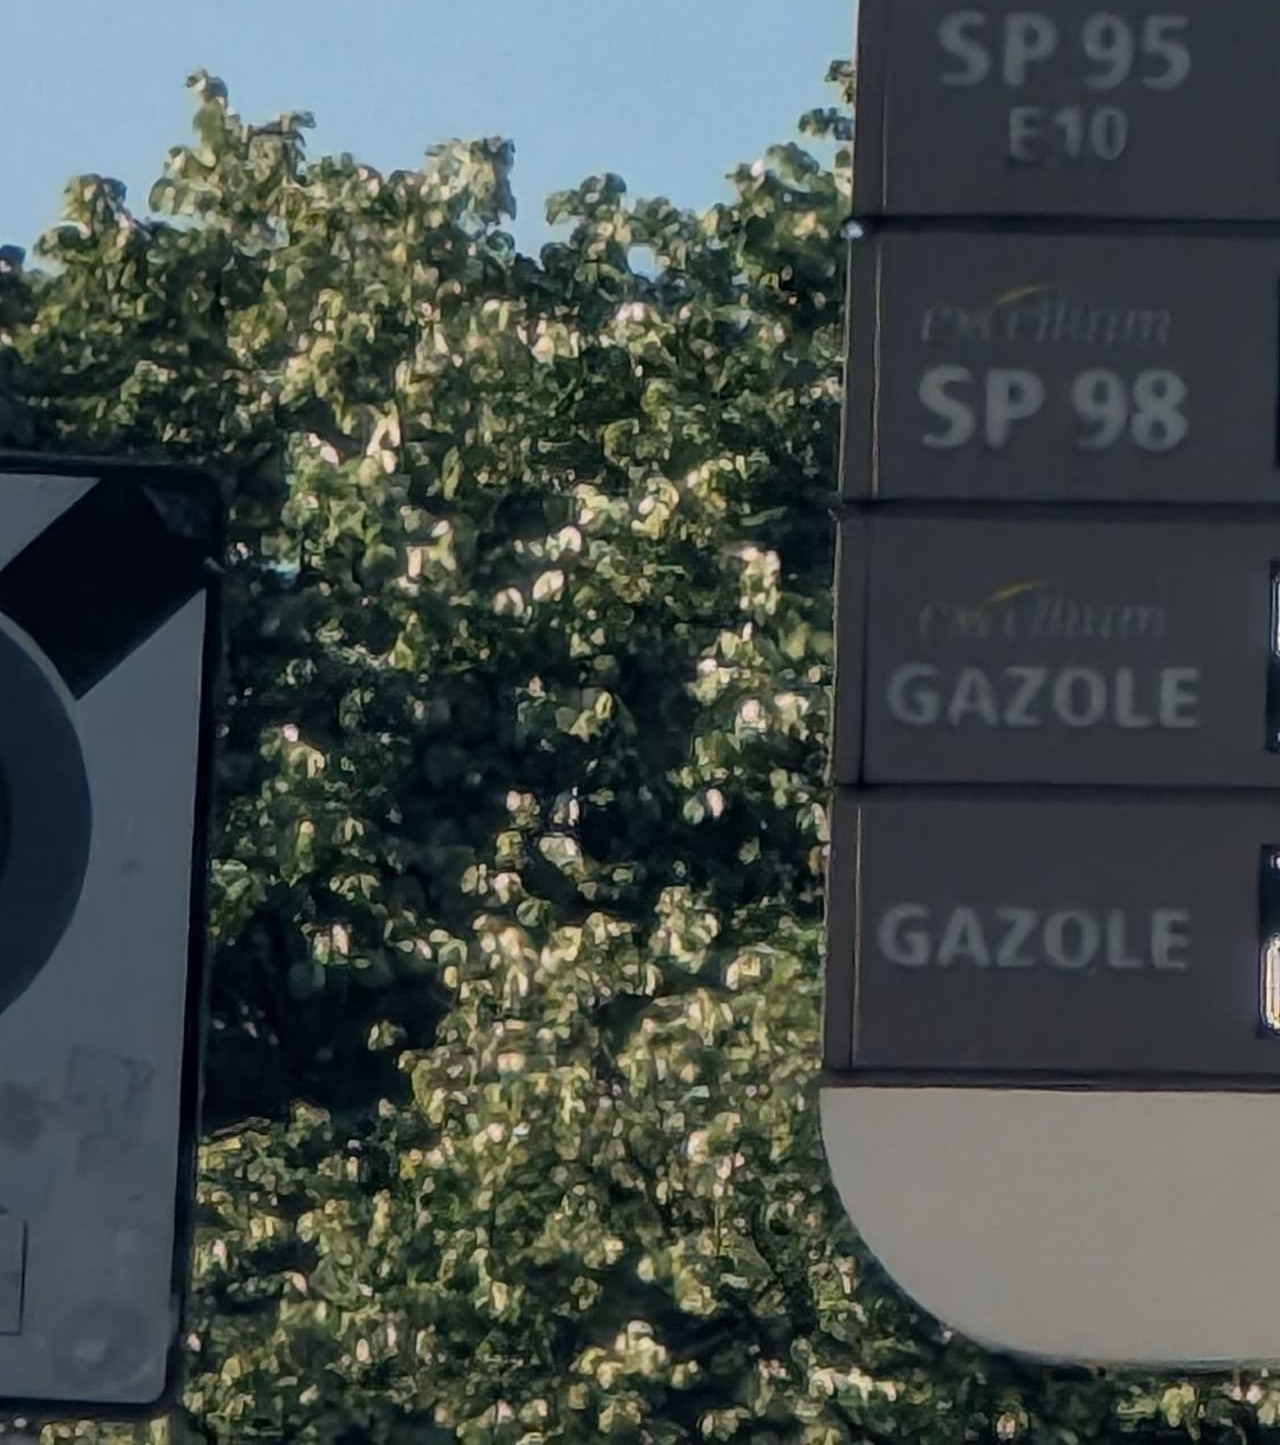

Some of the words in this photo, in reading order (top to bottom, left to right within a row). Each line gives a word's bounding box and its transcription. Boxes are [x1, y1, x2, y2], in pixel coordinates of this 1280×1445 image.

[938, 9, 1060, 89] SP
[1081, 10, 1193, 92] 95
[918, 363, 1046, 450] SP
[1071, 367, 1190, 453] 98
[886, 660, 1200, 729] GAZOLE
[877, 903, 1192, 973] GAZOLE
